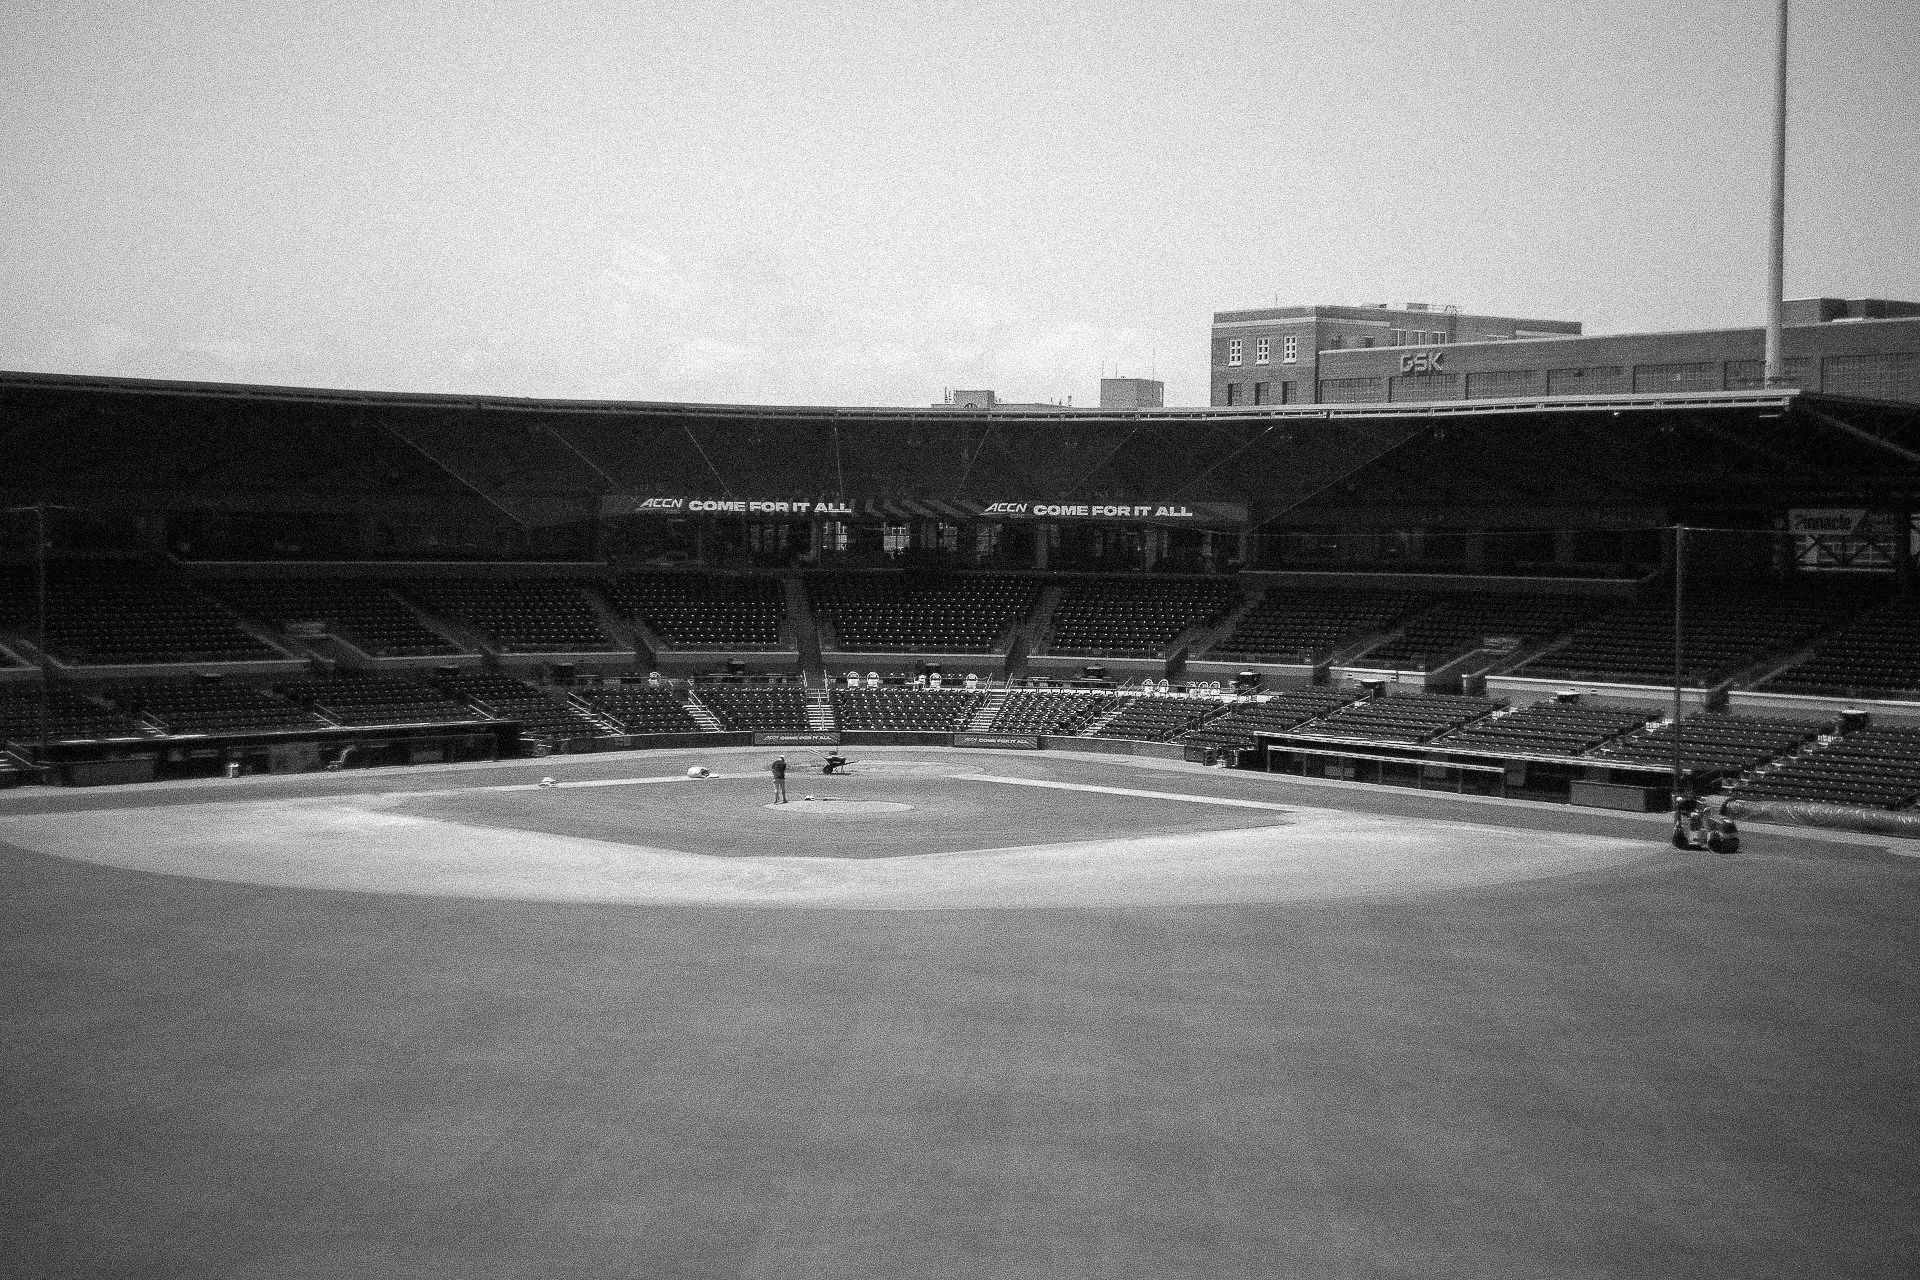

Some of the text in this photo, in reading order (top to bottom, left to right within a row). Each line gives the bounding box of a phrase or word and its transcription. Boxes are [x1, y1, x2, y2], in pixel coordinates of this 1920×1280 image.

[1400, 352, 1443, 372] GSK
[639, 498, 852, 513] ACCN COME FOR IT ALL
[982, 502, 1028, 514] ACCN
[1033, 504, 1088, 516] COME
[1091, 505, 1131, 517] FOR
[1134, 506, 1151, 517] IT
[1155, 506, 1193, 517] ALL
